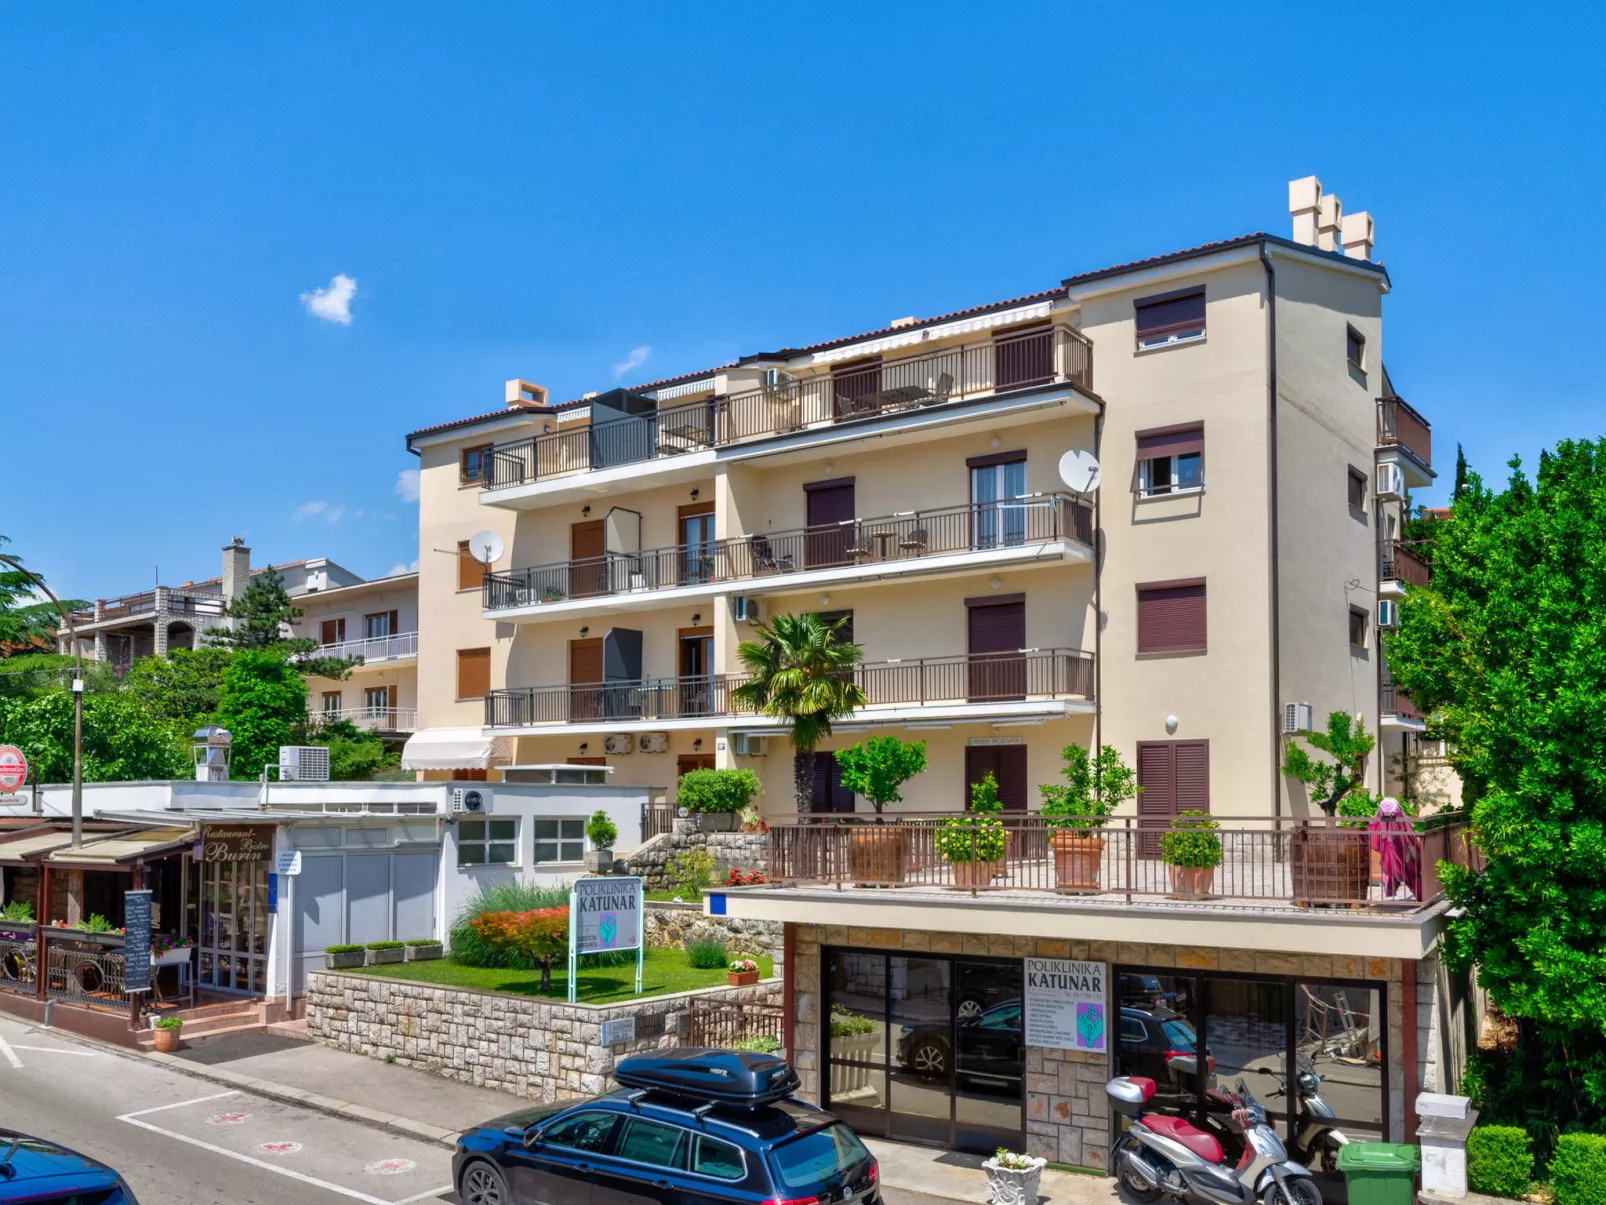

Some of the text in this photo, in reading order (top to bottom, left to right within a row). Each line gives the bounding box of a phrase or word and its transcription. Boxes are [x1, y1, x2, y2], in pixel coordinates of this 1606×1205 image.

[205, 841, 263, 862] Burin
[580, 883, 636, 897] POLIKLINIKA
[580, 895, 636, 912] KATUNAR
[1028, 960, 1102, 976] POLIKLINIKA
[1028, 972, 1102, 992] KATUNAR
